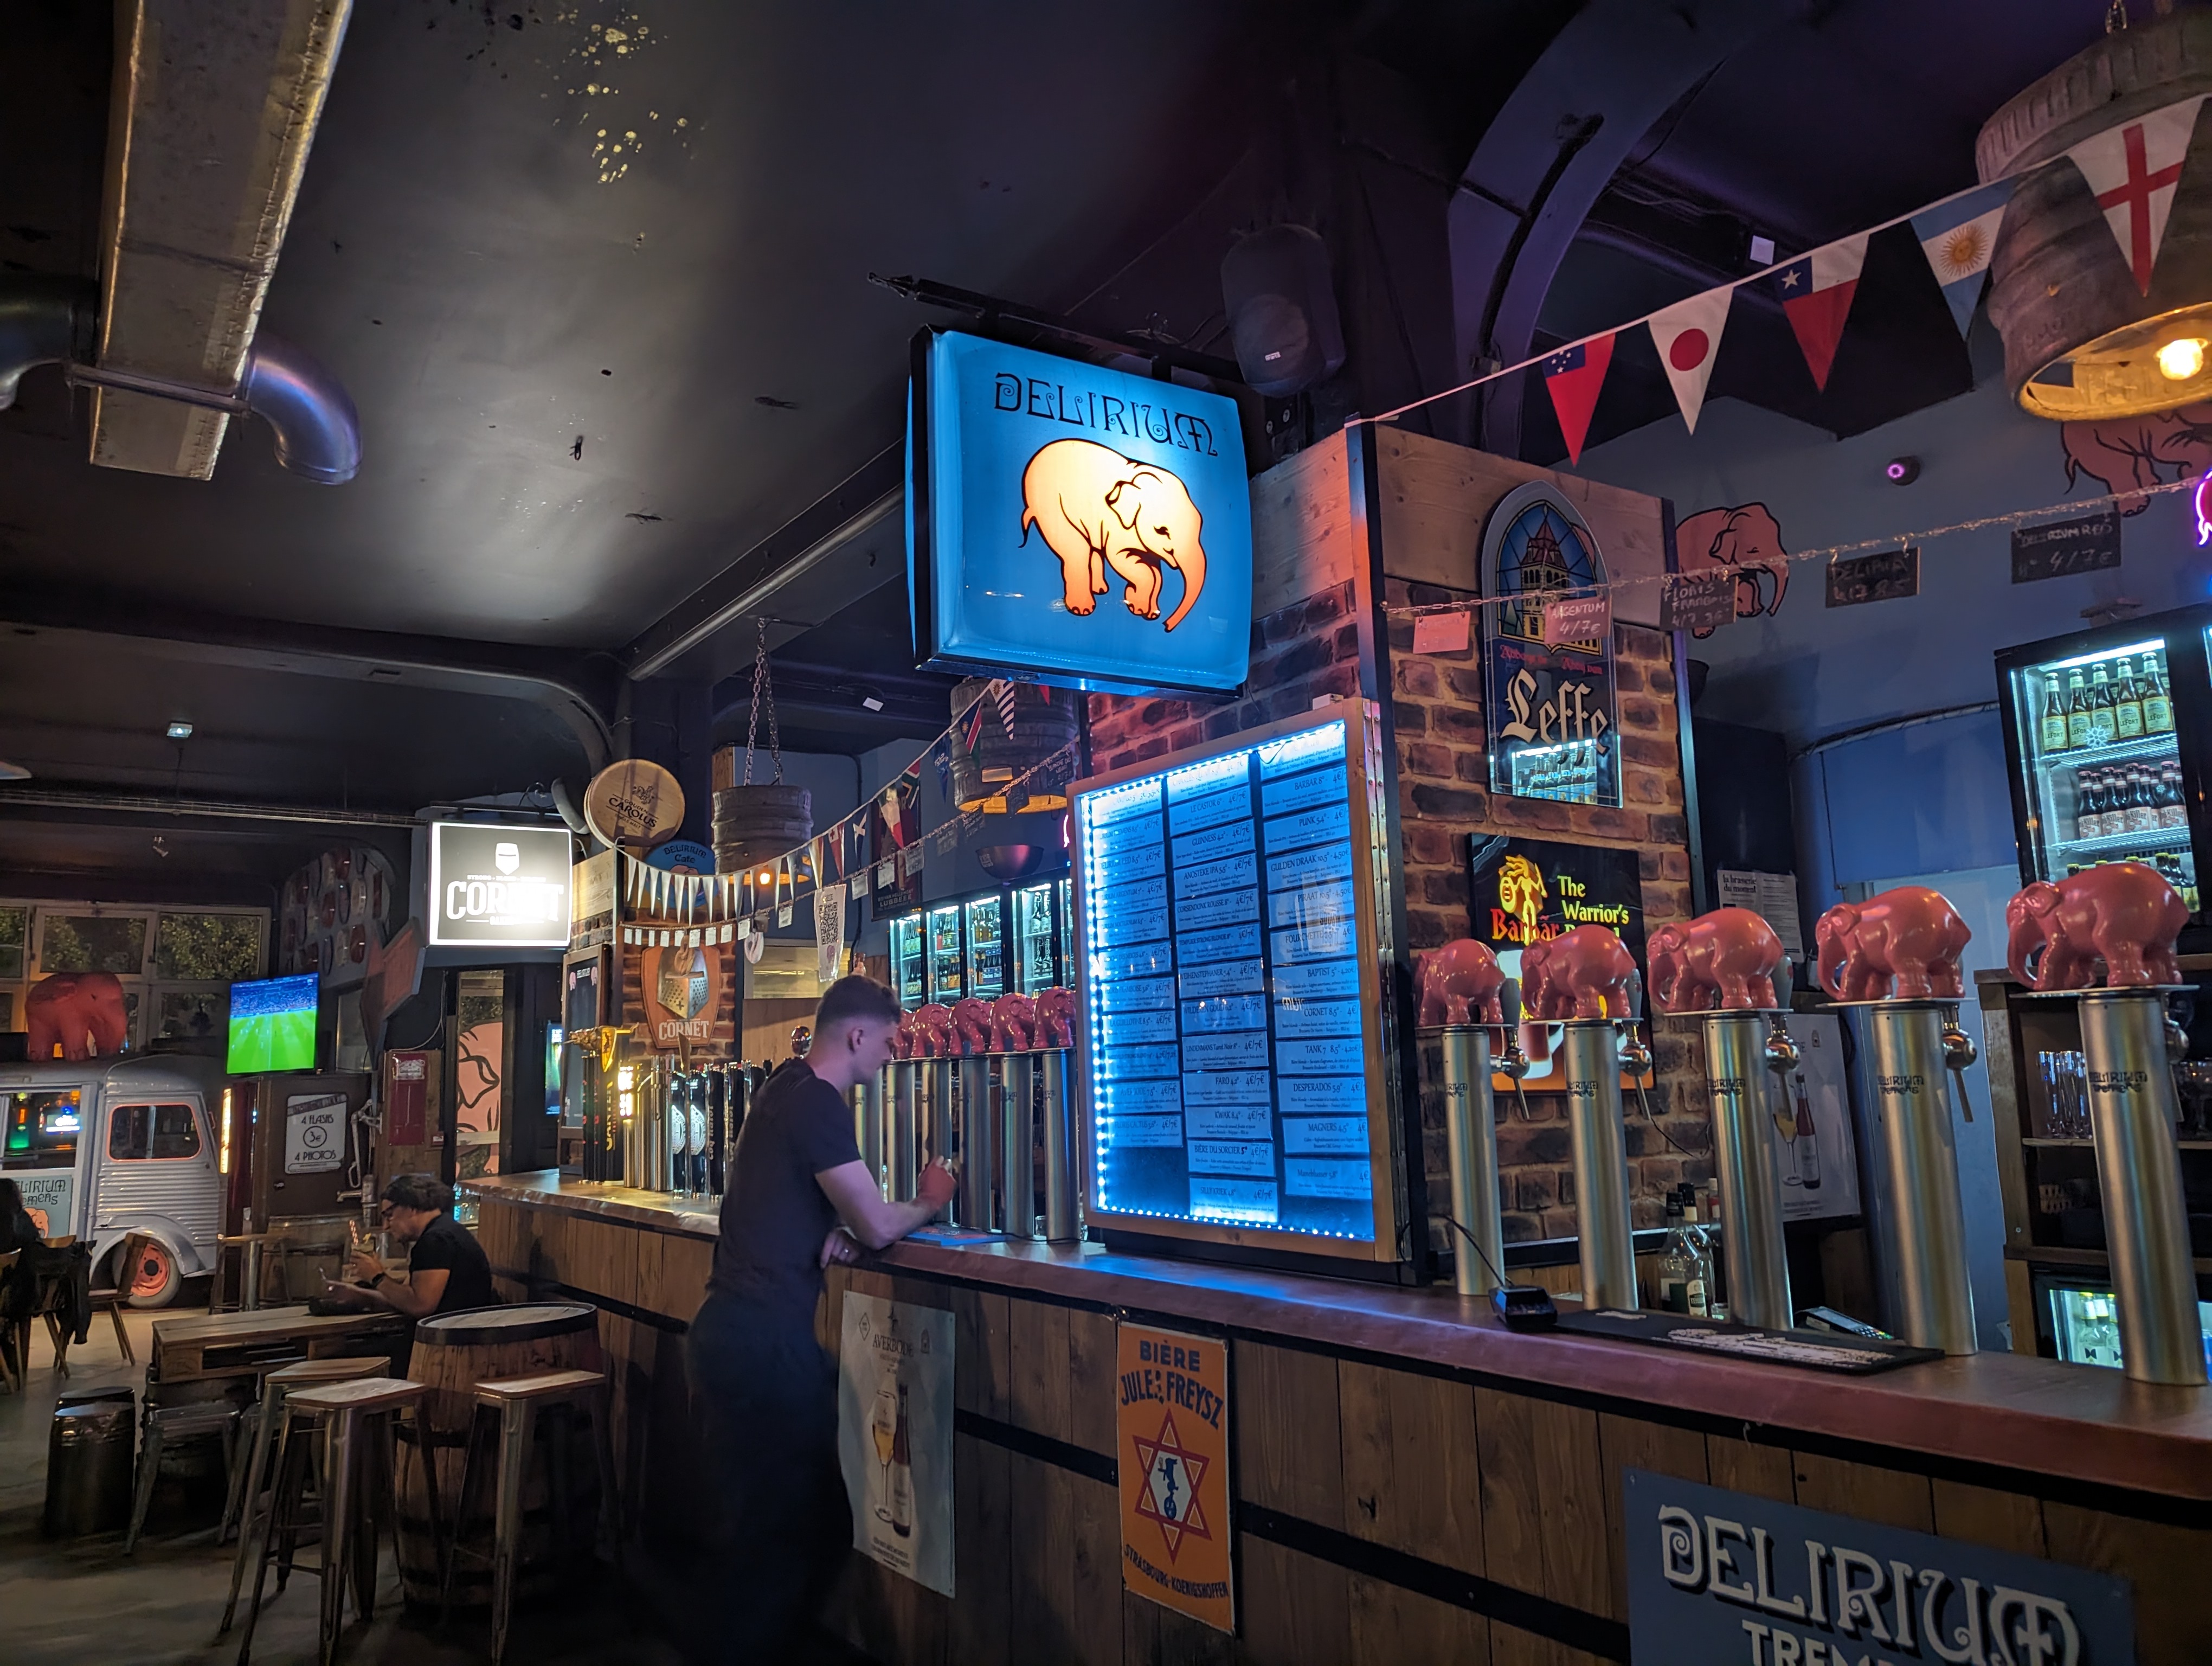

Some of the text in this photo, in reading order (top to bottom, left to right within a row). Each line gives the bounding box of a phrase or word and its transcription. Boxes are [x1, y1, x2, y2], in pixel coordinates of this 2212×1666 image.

[994, 372, 1218, 457] DELIRIUM
[1500, 668, 1610, 765] Leffe
[1295, 778, 1317, 790] BARBAR
[1197, 799, 1217, 811] CASTOR
[609, 798, 657, 828] CAROLUS
[1299, 816, 1316, 827] PUNK
[1192, 833, 1216, 846] GUINNESS
[1232, 825, 1250, 838] 4€/7€
[664, 844, 706, 858] DELIRIUM
[1234, 858, 1252, 872] 4€/7€
[1271, 860, 1295, 872] GULDEN
[1297, 855, 1316, 866] DRAAK
[1557, 875, 1586, 897] The
[1236, 893, 1254, 906] 4€/7€
[1298, 892, 1318, 902] PIRAAT
[1561, 900, 1629, 924] Warrior's
[1240, 964, 1258, 976] 4€/7€
[1308, 967, 1330, 977] BAPTIST
[1155, 982, 1171, 993] 4€/7€
[1241, 1000, 1261, 1012] 4€/7€
[1304, 1007, 1328, 1016] CORNET
[1156, 1015, 1172, 1026] 4€/7€
[659, 1021, 709, 1040] CORNET
[1244, 1040, 1263, 1051] 4€/7€
[1306, 1045, 1322, 1054] TANK
[1246, 1075, 1264, 1086] 4€/7€
[1161, 1085, 1176, 1096] 4€/7€
[1294, 1083, 1332, 1092] DESPERADOS
[301, 1116, 306, 1124] 4
[1248, 1110, 1266, 1122] 4€/7€
[1162, 1119, 1178, 1130] 4€/7€
[1308, 1123, 1338, 1131] MAGNERS
[304, 1150, 336, 1161] PHOTOS
[1218, 1146, 1241, 1155] SORCIER
[1251, 1146, 1269, 1158] 4€/7€
[1253, 1189, 1272, 1201] 4€/7€
[872, 1334, 914, 1357] AVERBODE
[1140, 1340, 1200, 1372] BIÈRE
[1167, 1371, 1224, 1431] FREYSZ
[1658, 1504, 2080, 1666] DELIRIUM
